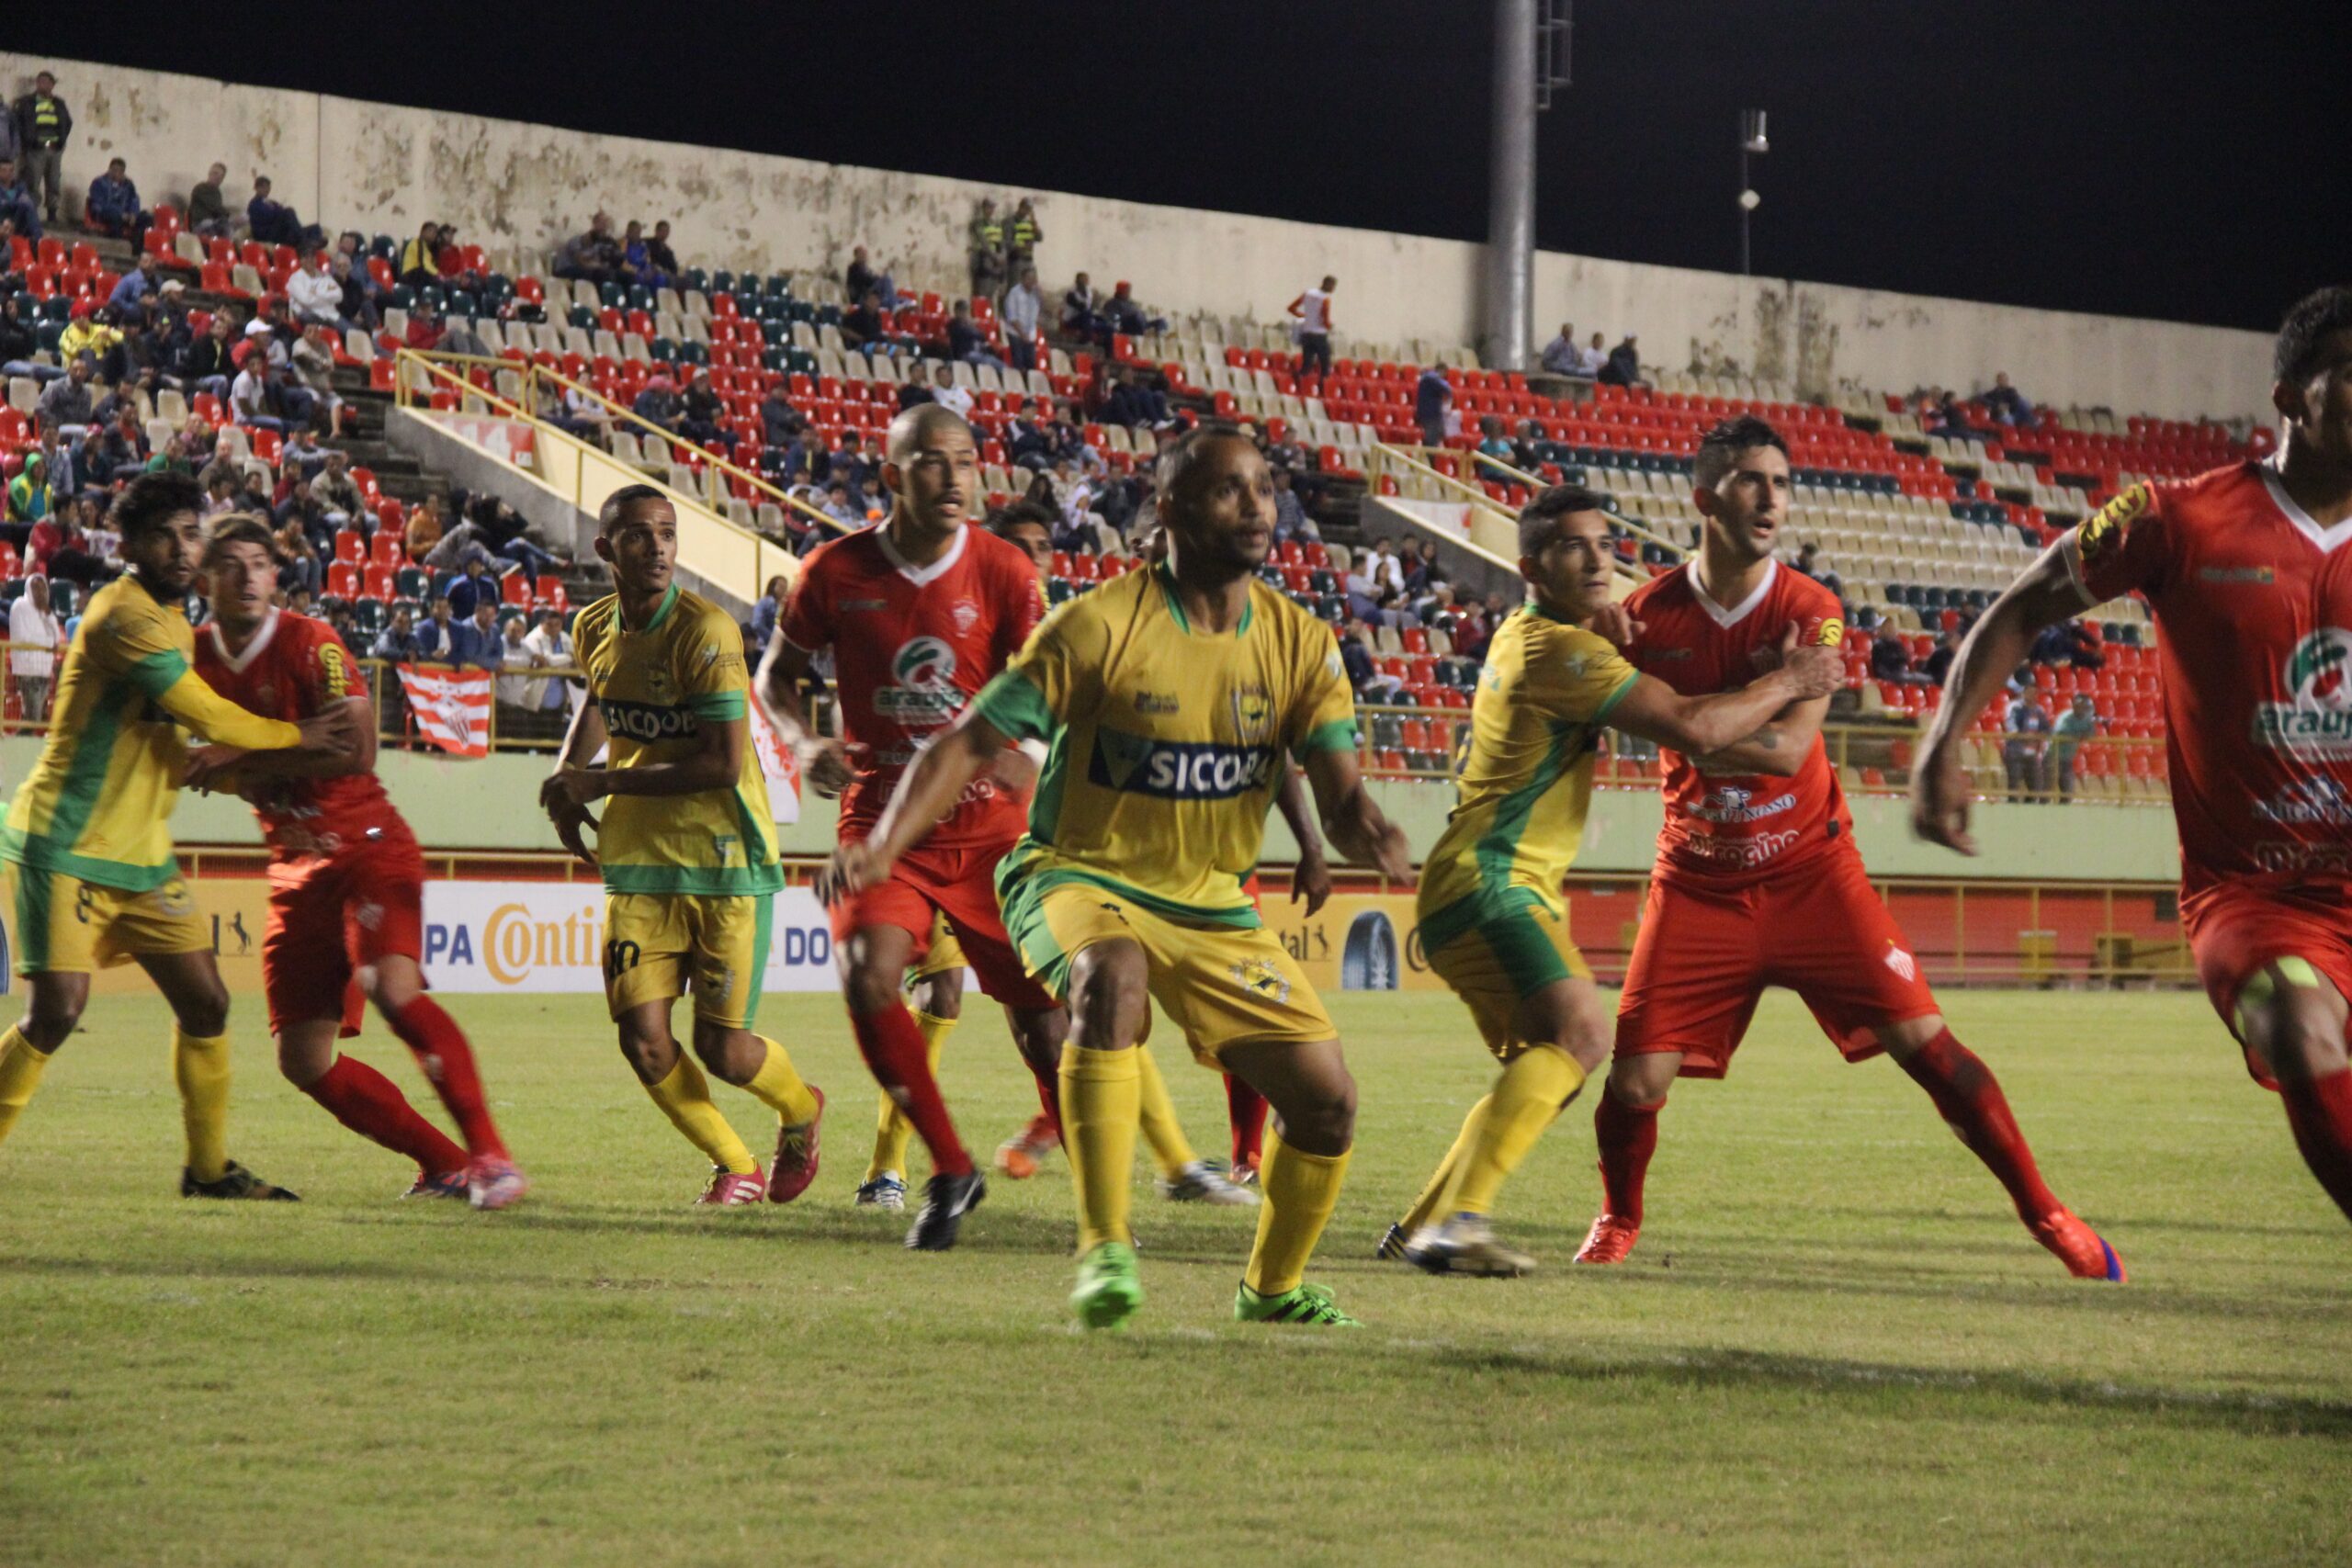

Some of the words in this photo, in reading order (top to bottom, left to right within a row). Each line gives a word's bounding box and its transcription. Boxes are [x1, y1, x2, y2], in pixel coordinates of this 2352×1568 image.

[482, 902, 605, 986] Conti
[785, 927, 830, 965] DO
[607, 939, 640, 979] 10
